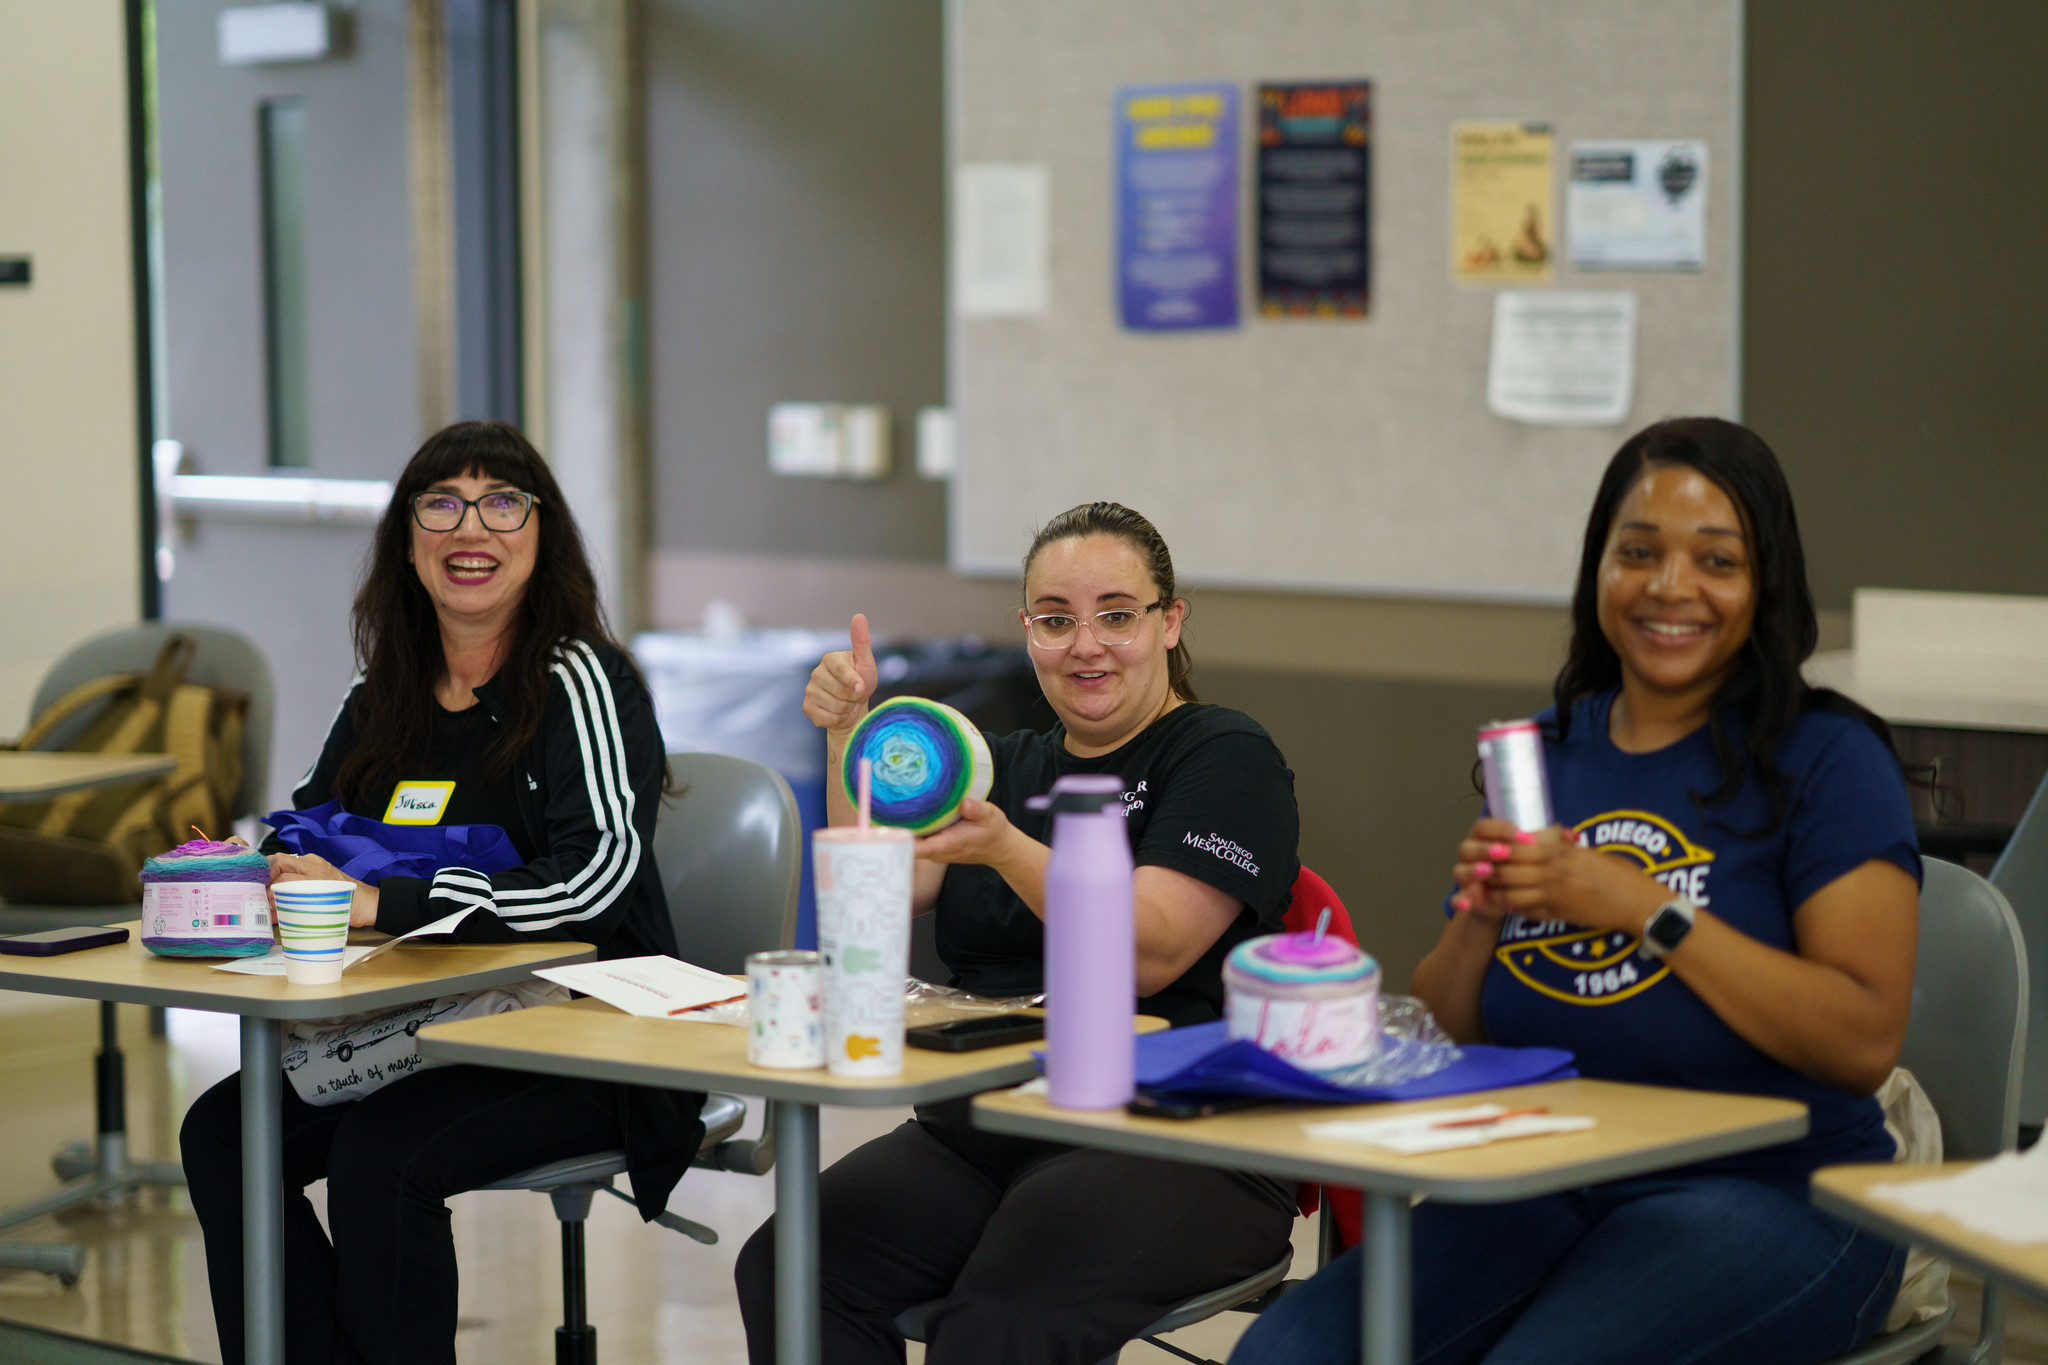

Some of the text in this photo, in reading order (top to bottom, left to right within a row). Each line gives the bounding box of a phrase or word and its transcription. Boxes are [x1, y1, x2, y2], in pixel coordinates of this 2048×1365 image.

[1595, 820, 1667, 854] DIEGO
[1574, 961, 1638, 996] 1964
[372, 1023, 395, 1037] TAXI
[328, 1068, 362, 1091] touch
[367, 1064, 384, 1080] of
[387, 1053, 422, 1072] magic
